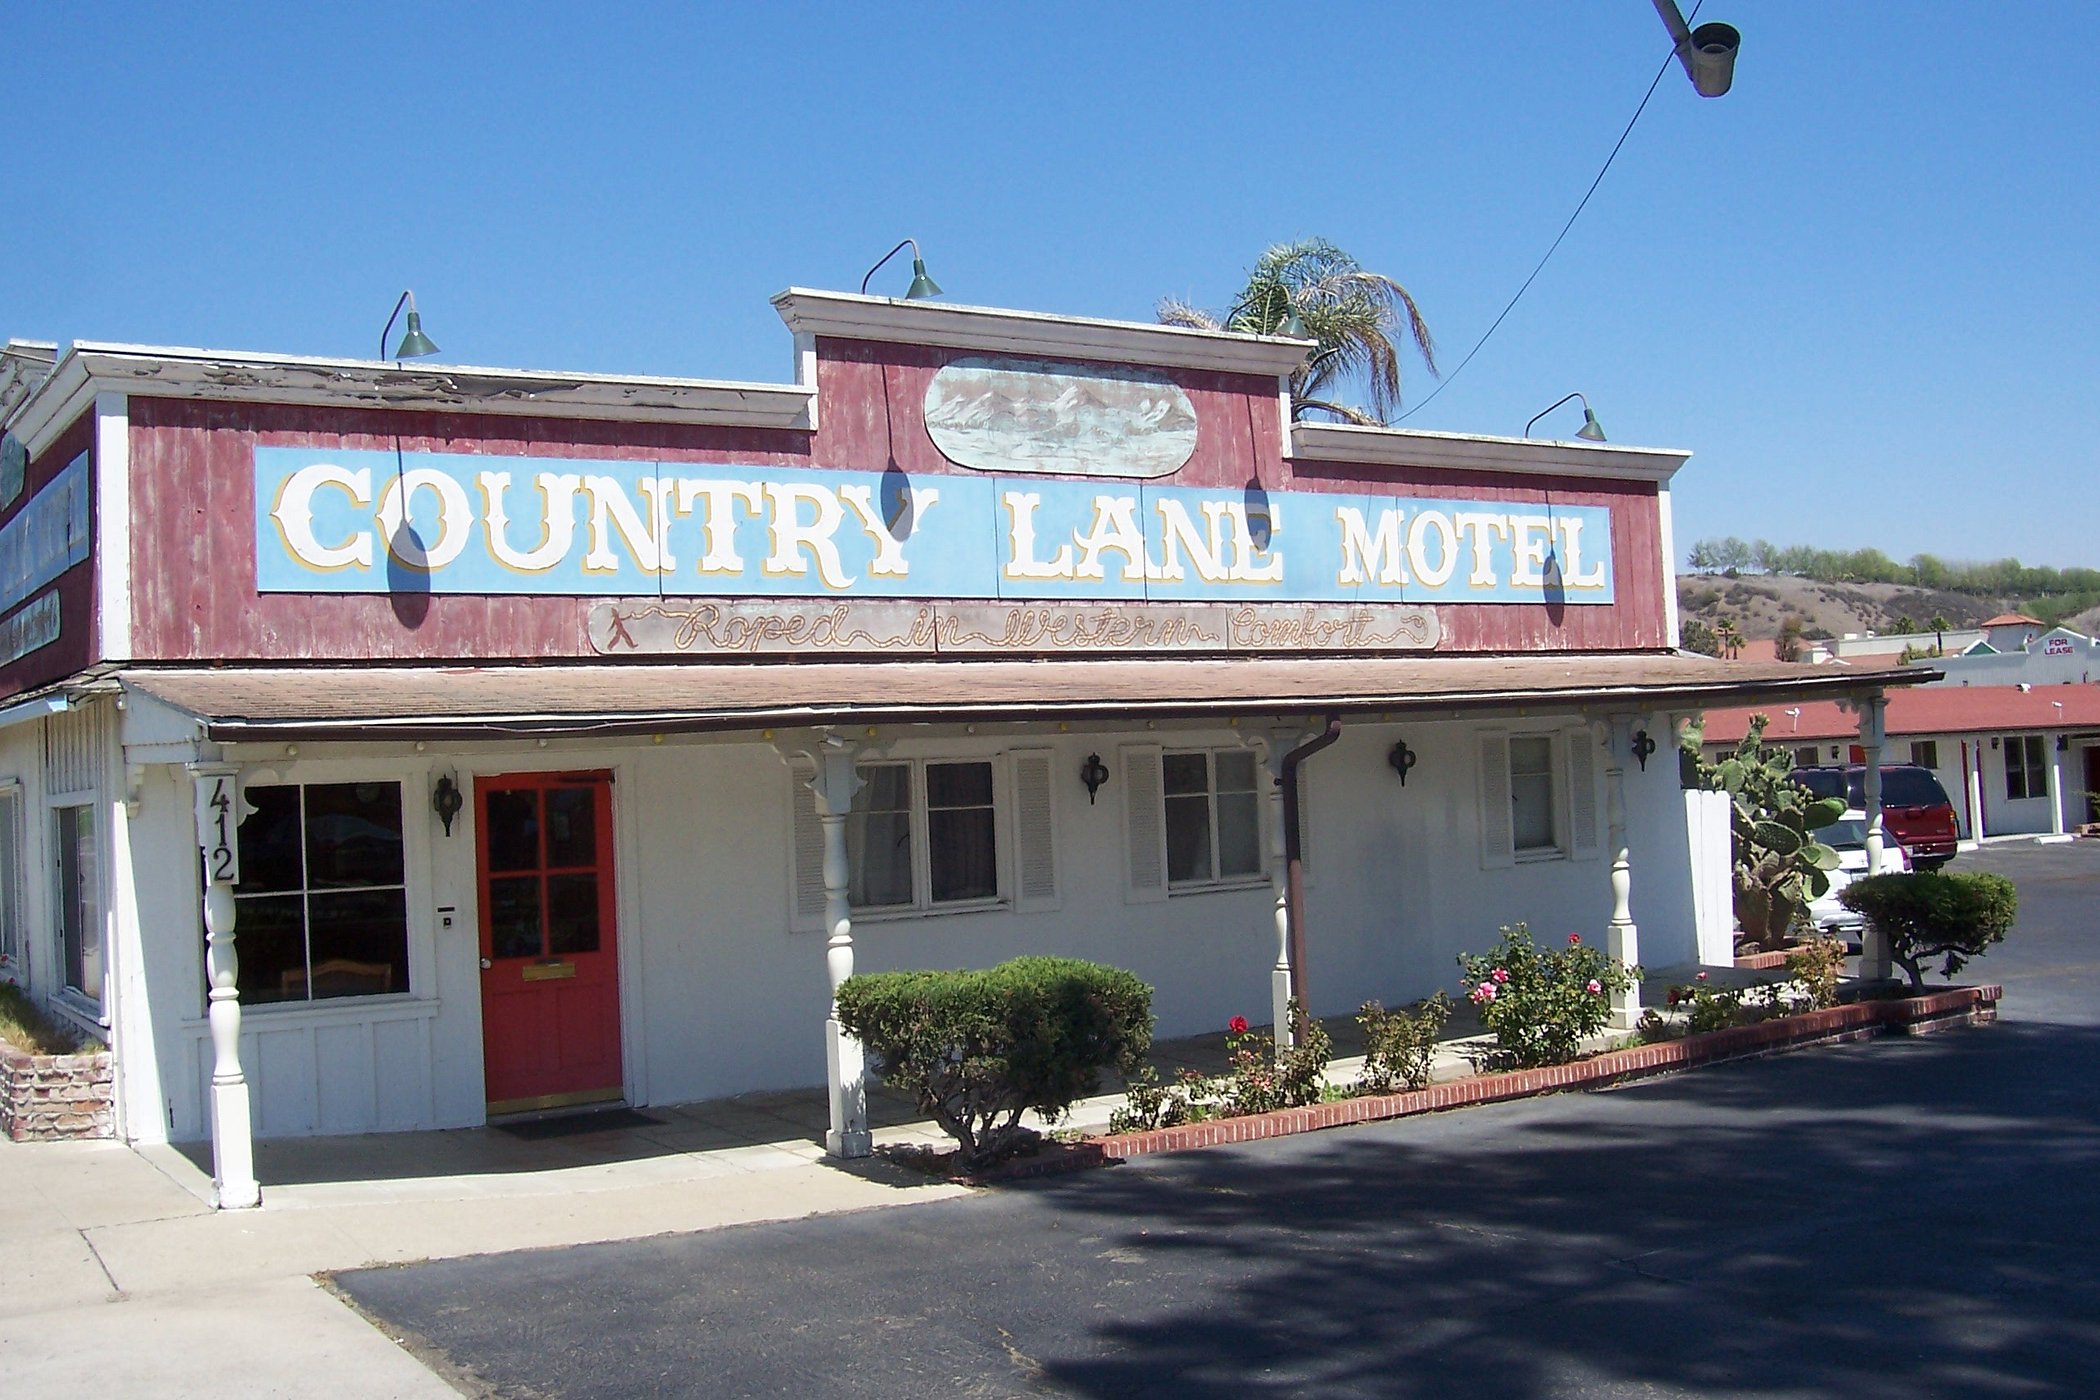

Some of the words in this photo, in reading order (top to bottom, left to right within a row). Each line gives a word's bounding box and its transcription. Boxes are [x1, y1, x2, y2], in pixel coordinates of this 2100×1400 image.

[269, 464, 939, 589] COUNTRY
[1001, 491, 1284, 583] LANE
[1336, 505, 1606, 590] MOTEL
[674, 604, 850, 650] Roped
[906, 608, 962, 647] in
[1005, 607, 1220, 648] Western
[1228, 607, 1376, 650] Comfort
[2048, 638, 2068, 647] FOR
[2044, 646, 2074, 655] LEASE
[210, 778, 235, 881] 412
